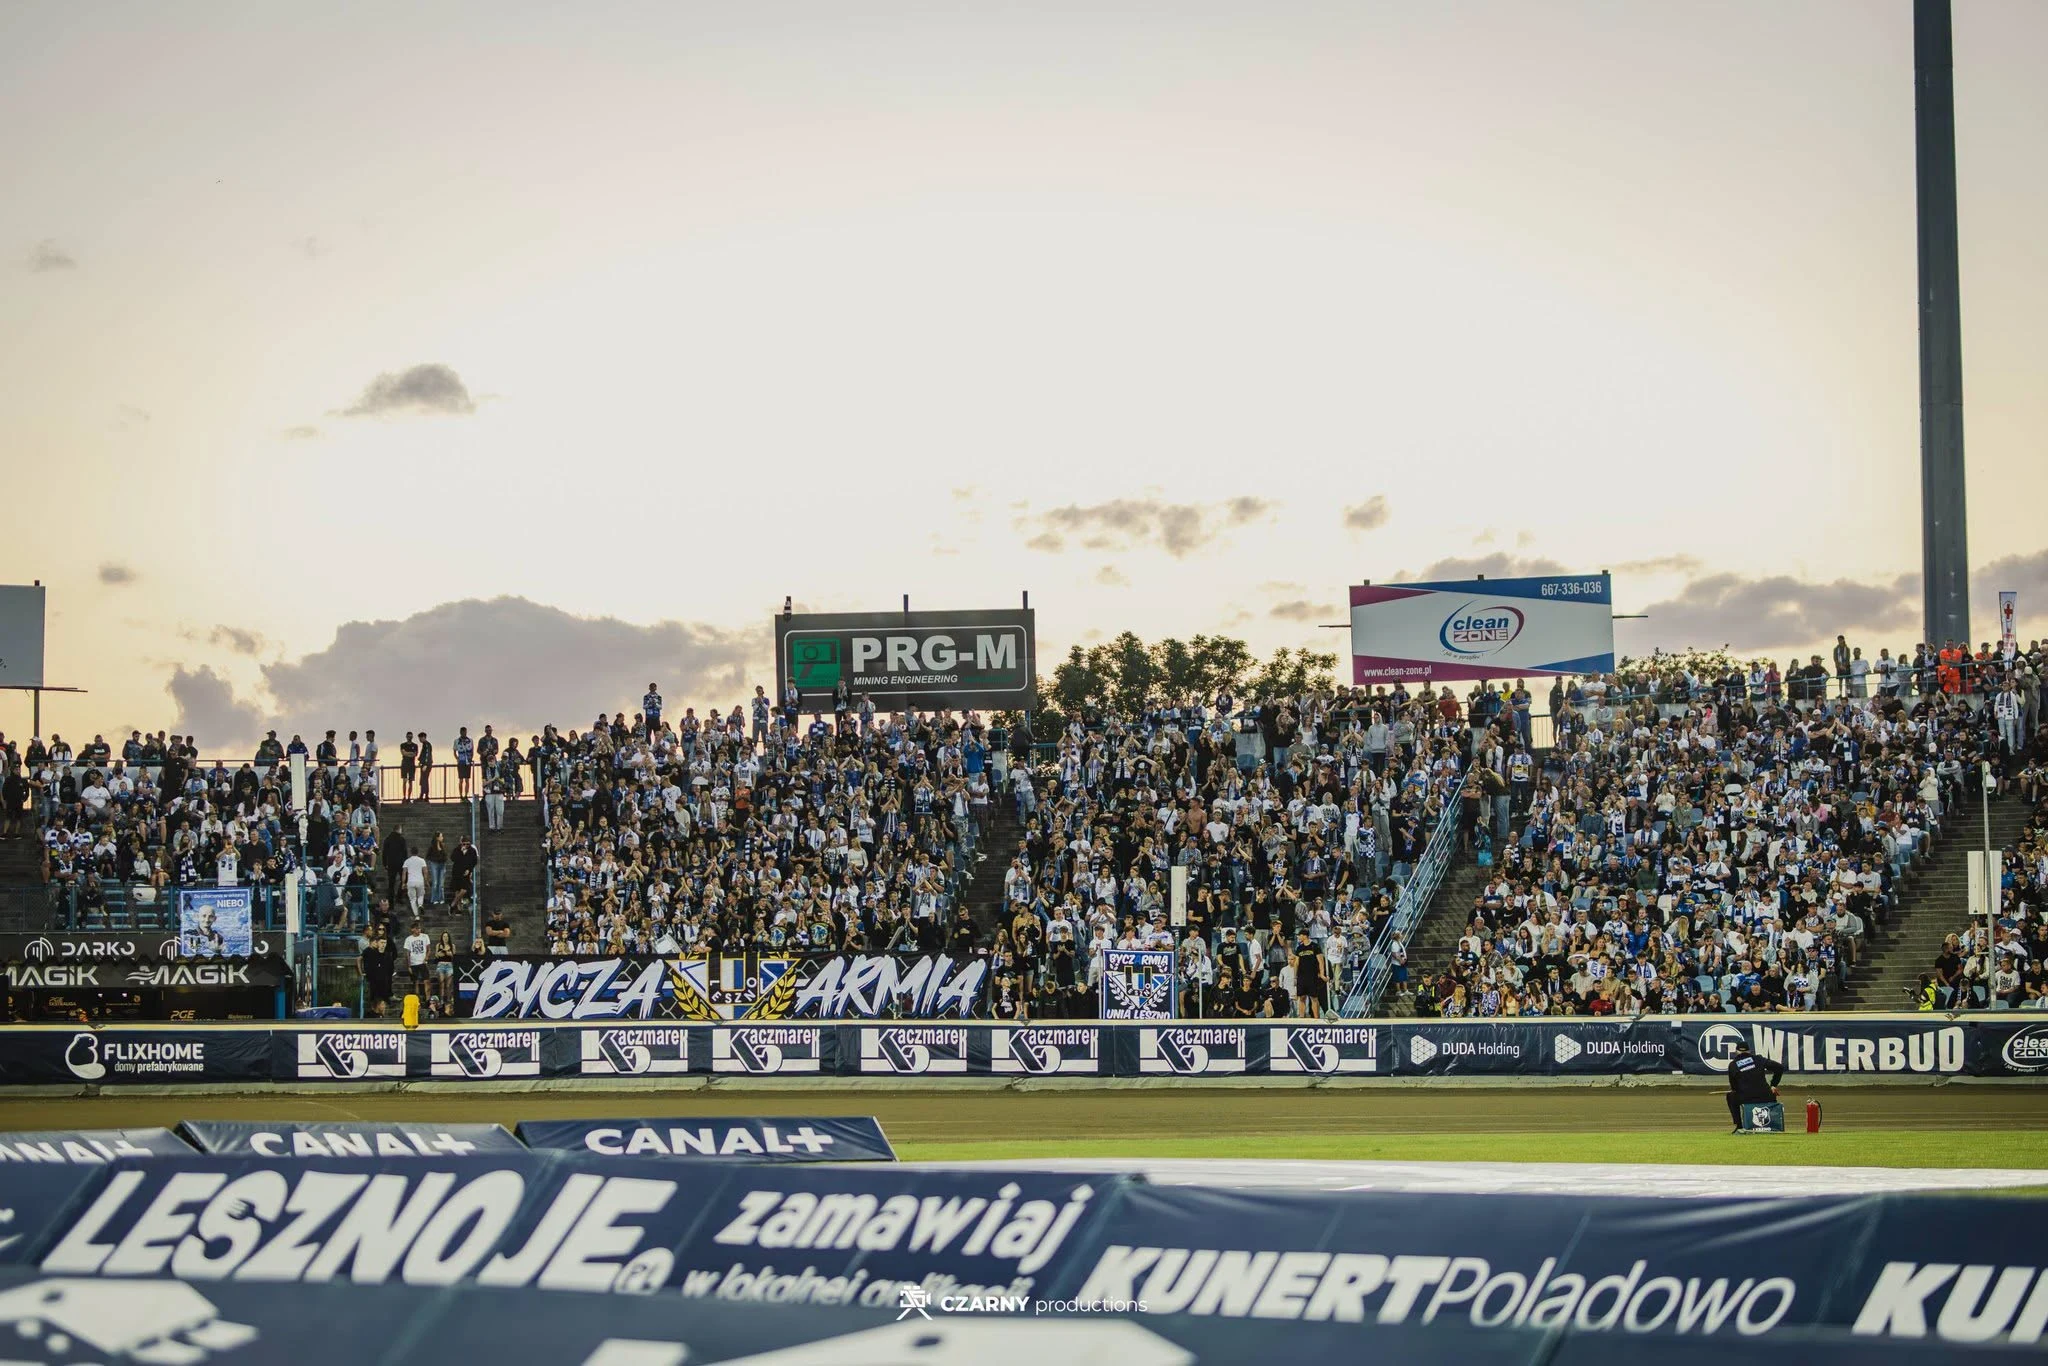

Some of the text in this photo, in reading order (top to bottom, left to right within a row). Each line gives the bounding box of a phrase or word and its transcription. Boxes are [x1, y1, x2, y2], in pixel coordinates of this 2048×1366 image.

[1541, 580, 1602, 596] 667-336-036
[1453, 616, 1509, 630] clean
[1454, 629, 1508, 642] ZONE
[852, 634, 1017, 673] PRG-M
[853, 674, 958, 686] MINING ENGINEERING
[1364, 665, 1432, 678] www.clean-zone.pl
[216, 899, 244, 908] NIEBO
[61, 942, 135, 956] DARKO
[474, 958, 665, 1020] BYCZA
[709, 976, 757, 1003] LESZNO
[794, 956, 987, 1019] ARMIA
[170, 1010, 196, 1019] PGE
[1106, 1009, 1171, 1019] UNIA LESZNO
[298, 1033, 407, 1078] Kaczmarek
[431, 1032, 540, 1077] Kaczmarek
[581, 1029, 688, 1073] Kaczmarek
[712, 1028, 820, 1073] Kaczmarek
[861, 1029, 967, 1073] Kaczmarek
[991, 1029, 1099, 1073] Kaczmarek
[1139, 1028, 1246, 1073] Kaczmarek
[1270, 1028, 1377, 1073] Kaczmarek
[1442, 1041, 1520, 1059] DUDA Holding
[1586, 1040, 1665, 1058] DUDA Holding
[1752, 1023, 1965, 1072] WILERBUD
[114, 1061, 204, 1074] domy prefabrykowane
[249, 1131, 476, 1157] CANAL+
[584, 1126, 834, 1156] CANAL+
[713, 1182, 1095, 1275] zamawiaj
[682, 1269, 721, 1299] w
